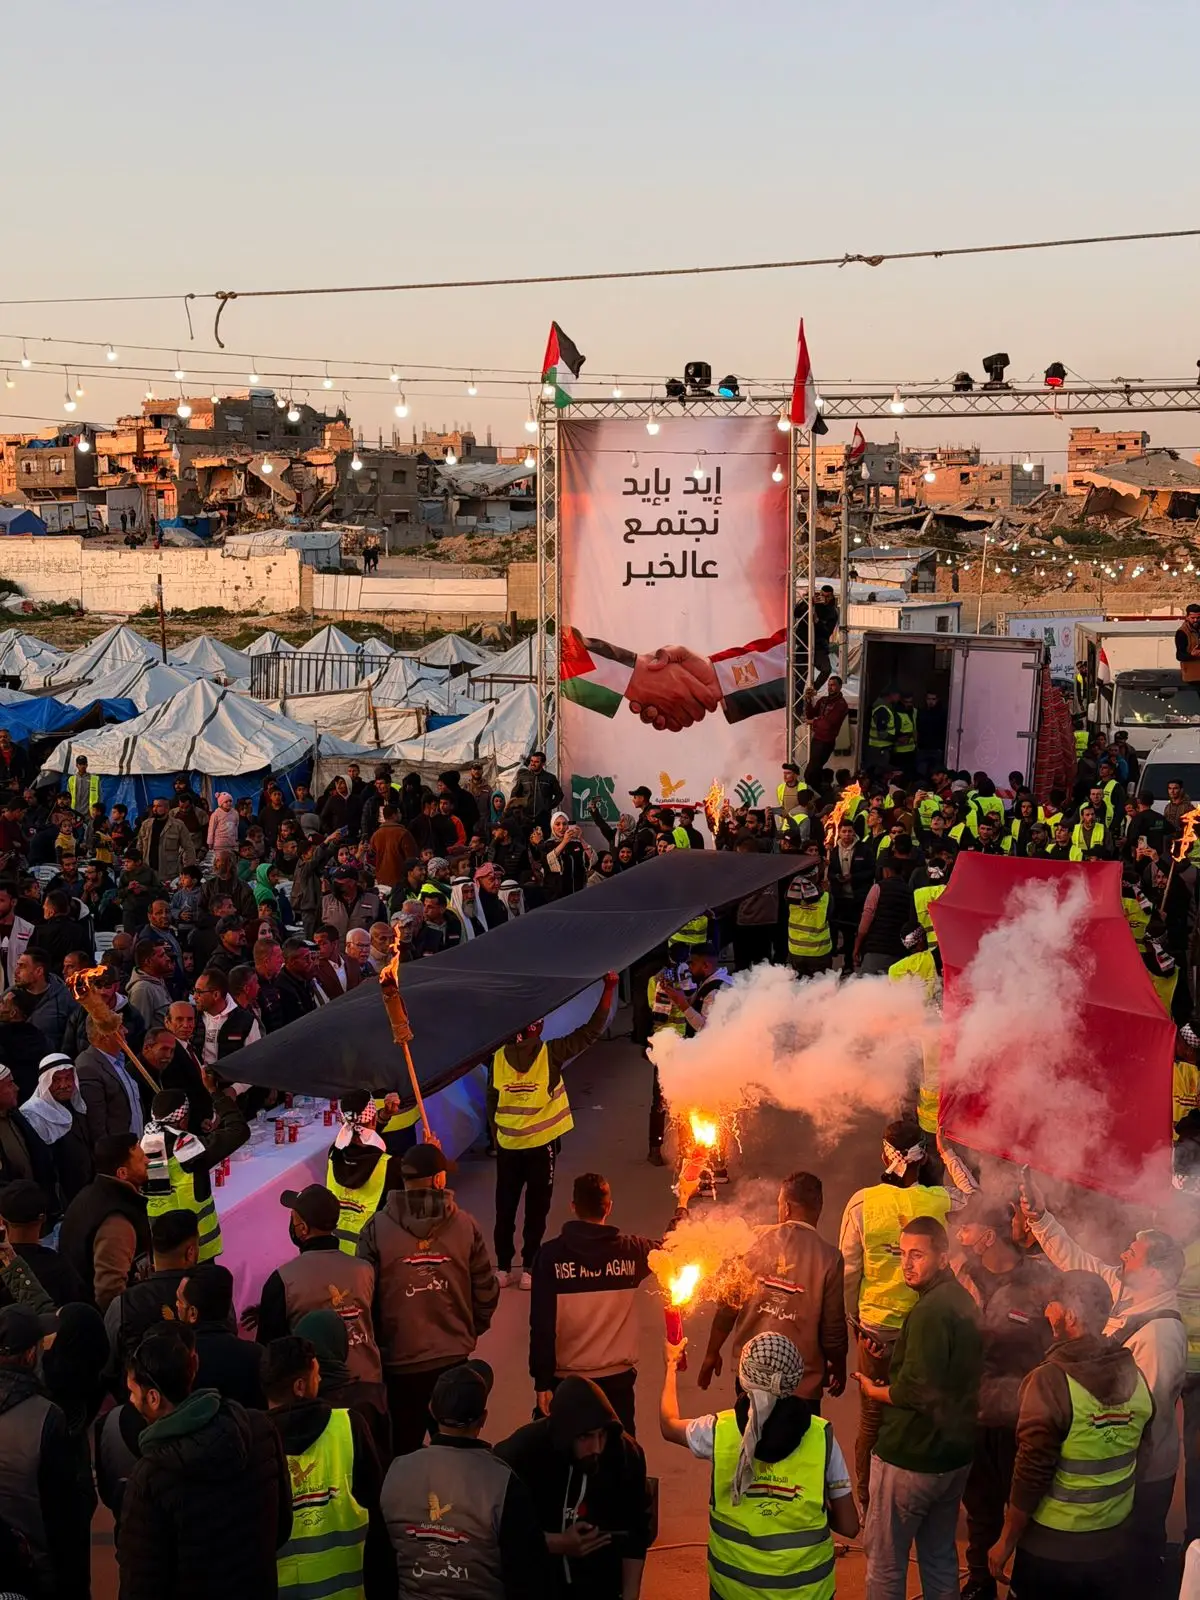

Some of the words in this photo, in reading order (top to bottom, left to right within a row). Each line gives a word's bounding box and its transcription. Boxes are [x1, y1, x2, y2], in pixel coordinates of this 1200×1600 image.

[622, 467, 671, 506] بإيد
[683, 467, 722, 505] إيد
[623, 509, 719, 544] نجتمع
[622, 550, 719, 587] عالخير
[406, 1276, 448, 1296] الأمن
[554, 1262, 577, 1279] RISE
[412, 1560, 469, 1580] الأمن
